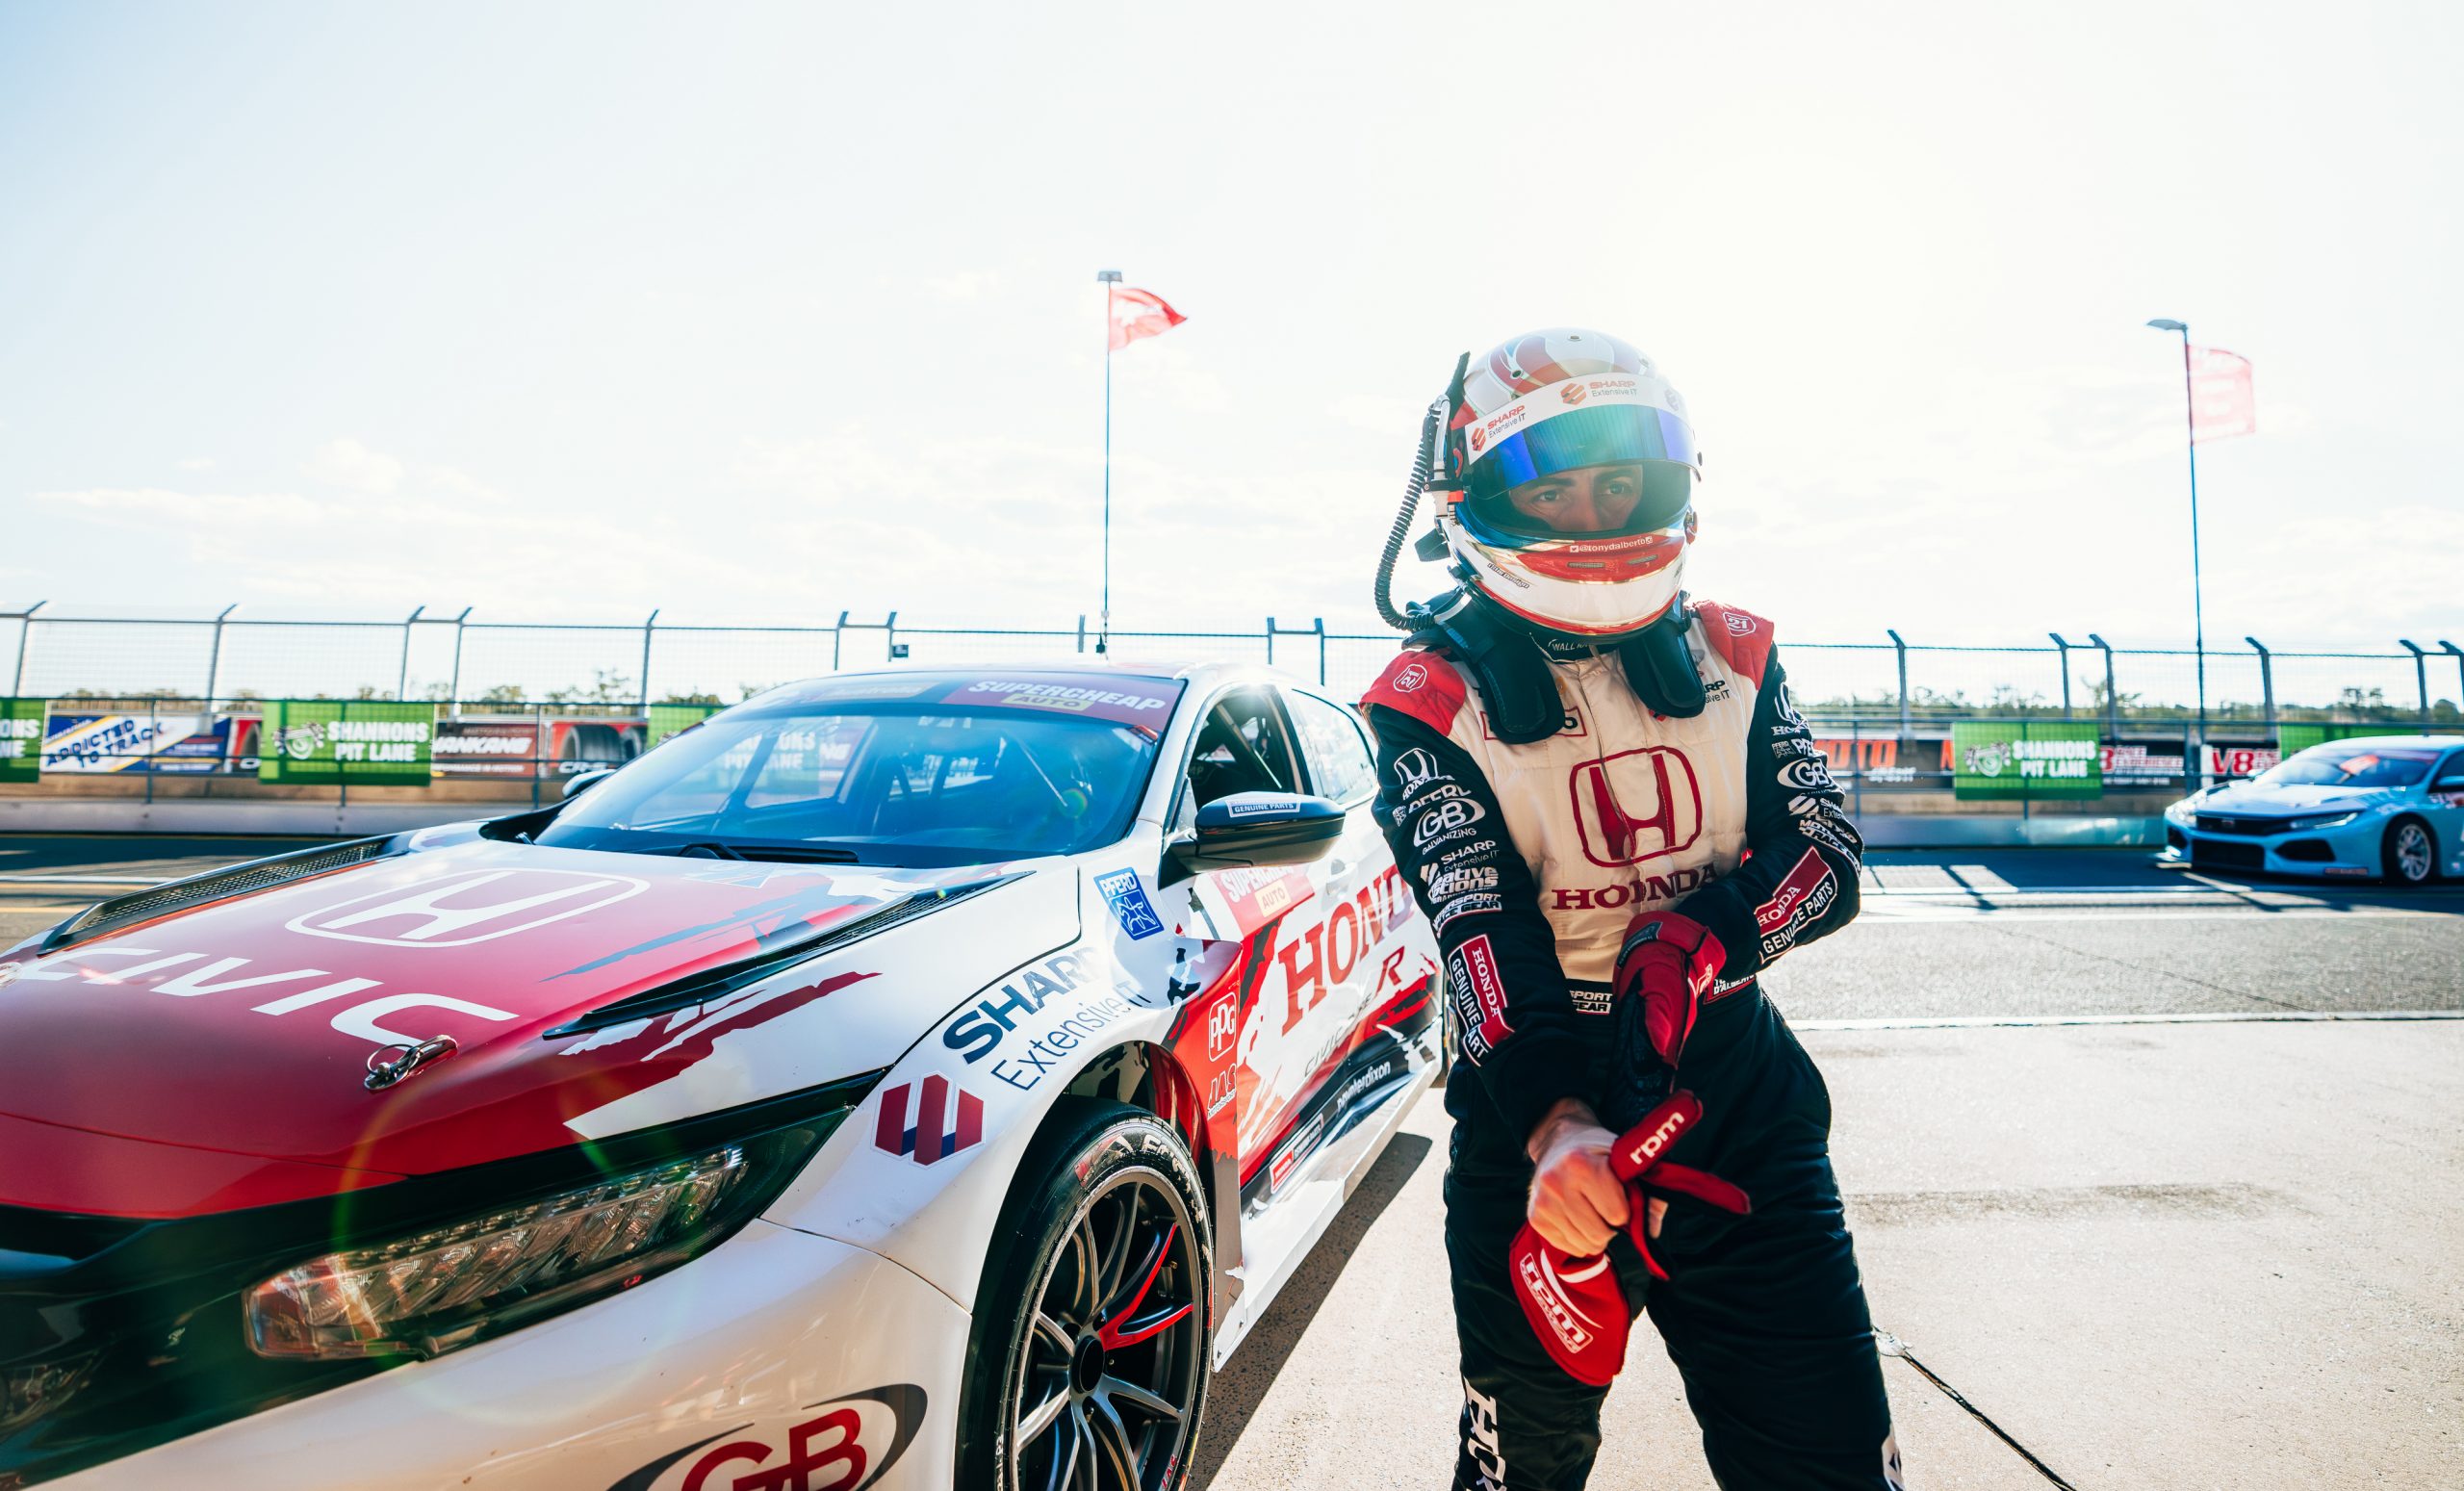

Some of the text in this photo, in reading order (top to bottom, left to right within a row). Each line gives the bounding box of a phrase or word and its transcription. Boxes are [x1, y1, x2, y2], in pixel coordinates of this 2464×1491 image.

[1589, 381, 1635, 390] SHARP
[1487, 405, 1526, 430] SHARP
[1489, 413, 1527, 439] Extensive IT
[968, 681, 1166, 710] SUPERCHEAP
[1014, 695, 1082, 708] AUTO
[46, 719, 136, 767] ADDICTED
[327, 721, 429, 743] SHANNONS
[335, 742, 417, 762] PIT LANE
[2012, 740, 2096, 759] SHANNONS
[2212, 749, 2255, 776] V8
[1795, 761, 1829, 786] GB
[2022, 760, 2089, 779] PIT LANE
[1235, 803, 1269, 813] GENUINE
[1423, 801, 1467, 837] GB
[1441, 839, 1496, 864] SHARP
[1099, 871, 1138, 897] PFERD
[1552, 862, 1717, 911] HONDA
[1261, 887, 1287, 911] AUTO
[1806, 880, 1834, 916] PARTS
[1472, 946, 1502, 1017] HONDA
[21, 947, 521, 1053] CIVIC
[942, 945, 1103, 1066] SHARP
[1451, 957, 1489, 1059] GENUINE ART
[1575, 1002, 1609, 1013] EAR
[1210, 1002, 1236, 1052] PPG
[990, 993, 1131, 1092] Extensive
[1630, 1112, 1684, 1166] rpm
[1525, 1259, 1588, 1346] rpm
[680, 1407, 867, 1491] GB
